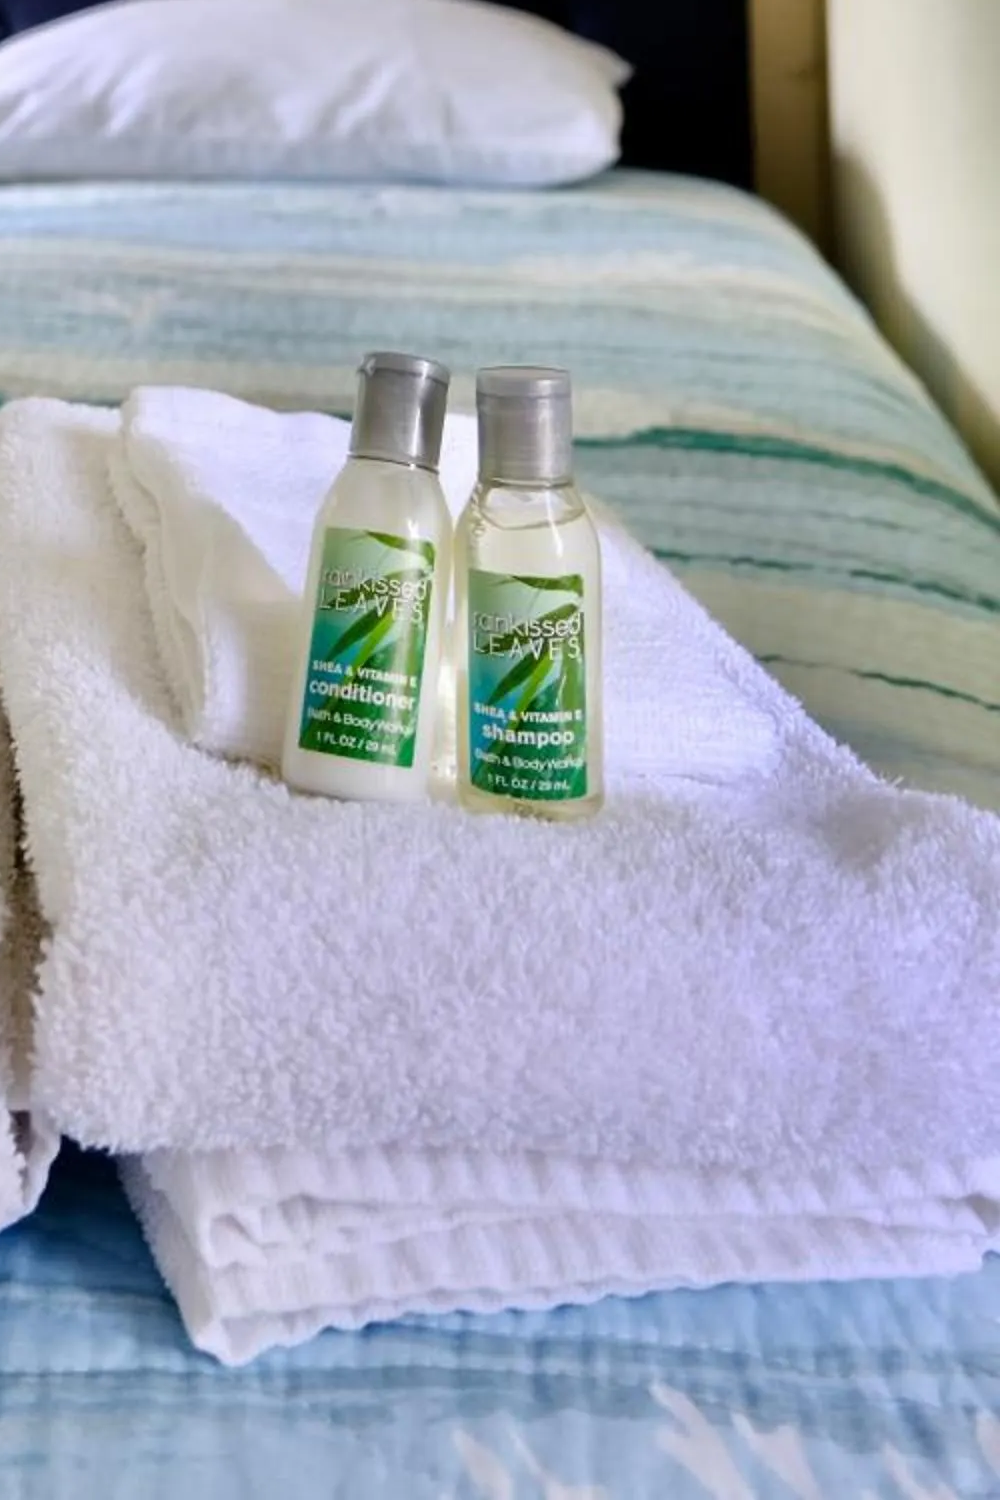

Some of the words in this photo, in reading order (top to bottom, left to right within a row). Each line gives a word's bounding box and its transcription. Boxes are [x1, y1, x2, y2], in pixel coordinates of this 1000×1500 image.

[319, 588, 423, 622] LEAVES
[312, 660, 342, 674] SHEA
[409, 676, 418, 688] E
[309, 680, 415, 711] conditioner
[474, 702, 505, 719] SHEA
[520, 711, 573, 724] VITAMIN
[574, 709, 583, 721] E
[339, 735, 356, 748] OZ
[482, 723, 575, 750] shampoo
[511, 777, 528, 790] OZ
